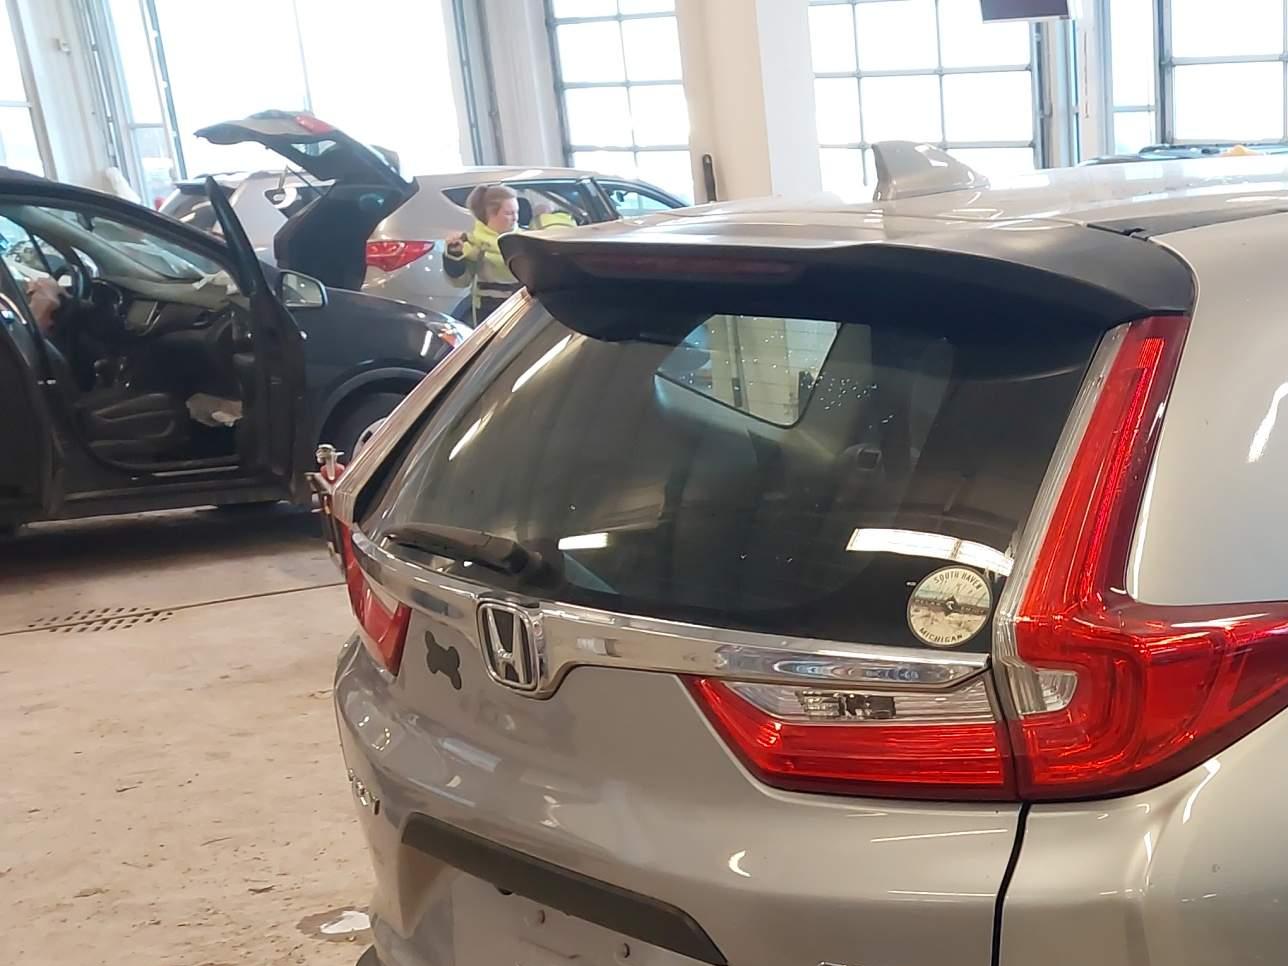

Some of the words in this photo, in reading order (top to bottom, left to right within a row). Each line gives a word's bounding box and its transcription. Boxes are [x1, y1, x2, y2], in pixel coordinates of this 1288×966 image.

[933, 570, 960, 584] SOUTH
[961, 570, 983, 590] HAVEN
[918, 626, 964, 643] MICHIGAN
